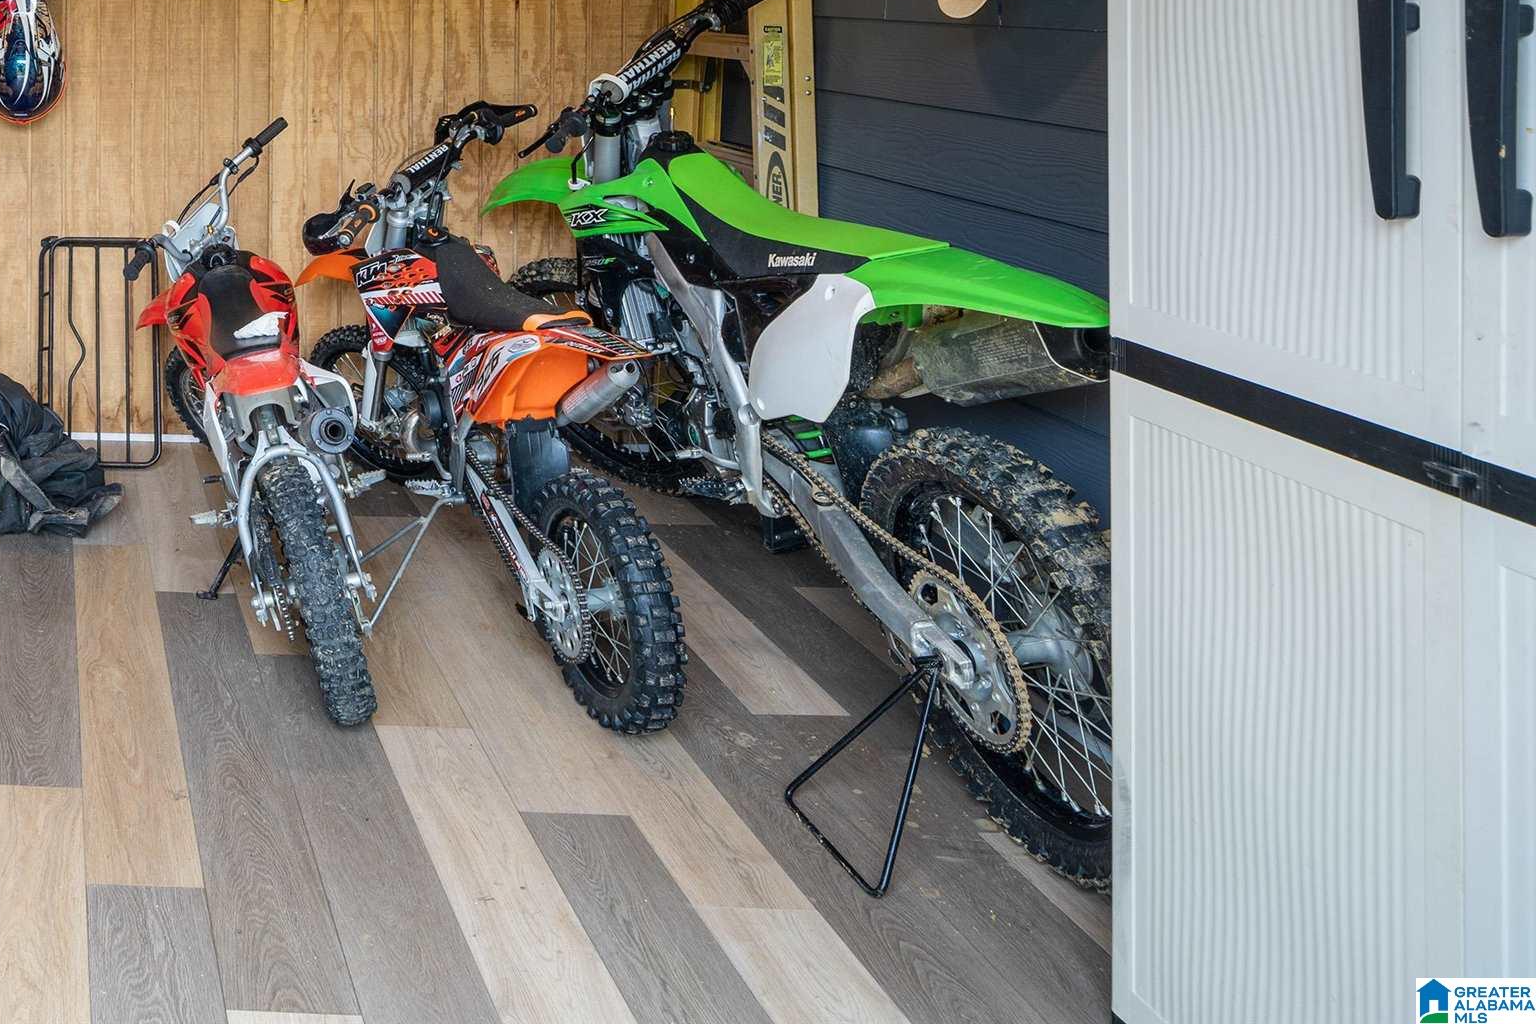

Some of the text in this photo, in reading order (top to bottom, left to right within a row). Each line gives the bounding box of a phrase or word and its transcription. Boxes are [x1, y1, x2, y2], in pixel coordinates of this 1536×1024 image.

[406, 143, 449, 174] RENTHAL
[570, 208, 609, 227] KX
[767, 252, 818, 268] Kawasaki
[356, 261, 387, 288] KTM
